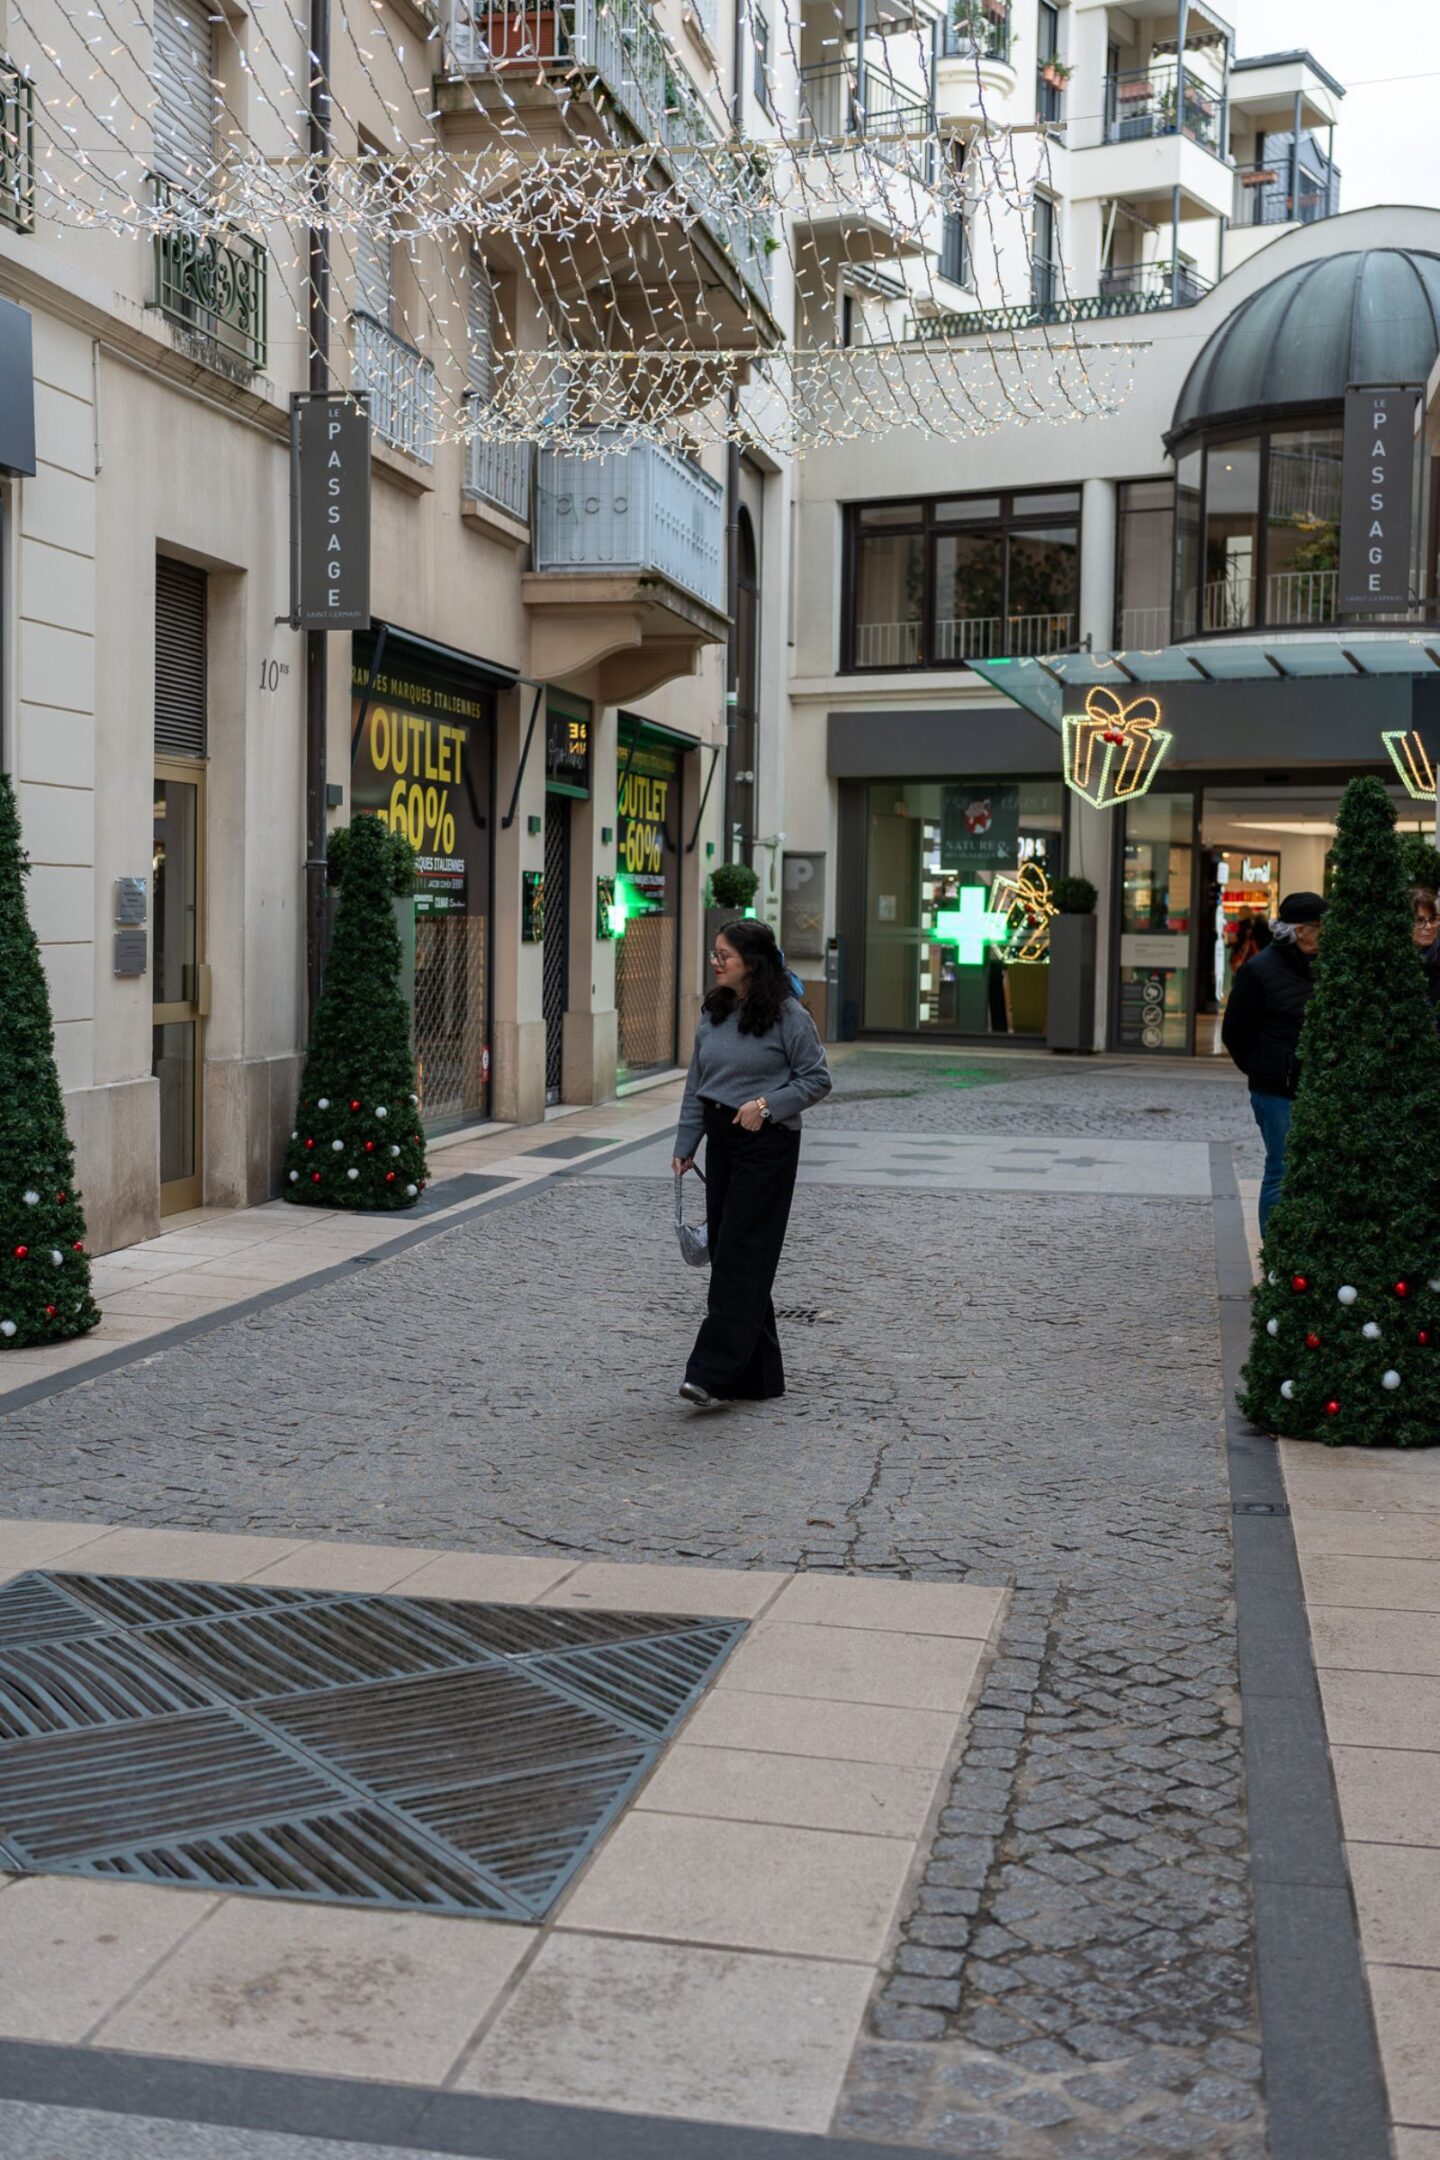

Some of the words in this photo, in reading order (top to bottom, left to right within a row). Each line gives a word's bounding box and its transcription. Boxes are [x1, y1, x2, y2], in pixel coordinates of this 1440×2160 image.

[328, 408, 341, 418] LE
[1374, 399, 1386, 409] LE
[327, 422, 342, 607] PASSAGE
[1368, 412, 1388, 592] PASSAGE
[390, 678, 432, 705] MARQUES
[433, 691, 481, 719] ITALIENNES
[370, 706, 466, 785] OUTLET
[377, 779, 456, 855] -60%
[434, 857, 465, 873] ITALIENNES
[619, 820, 661, 873] -60%
[784, 859, 814, 891] P
